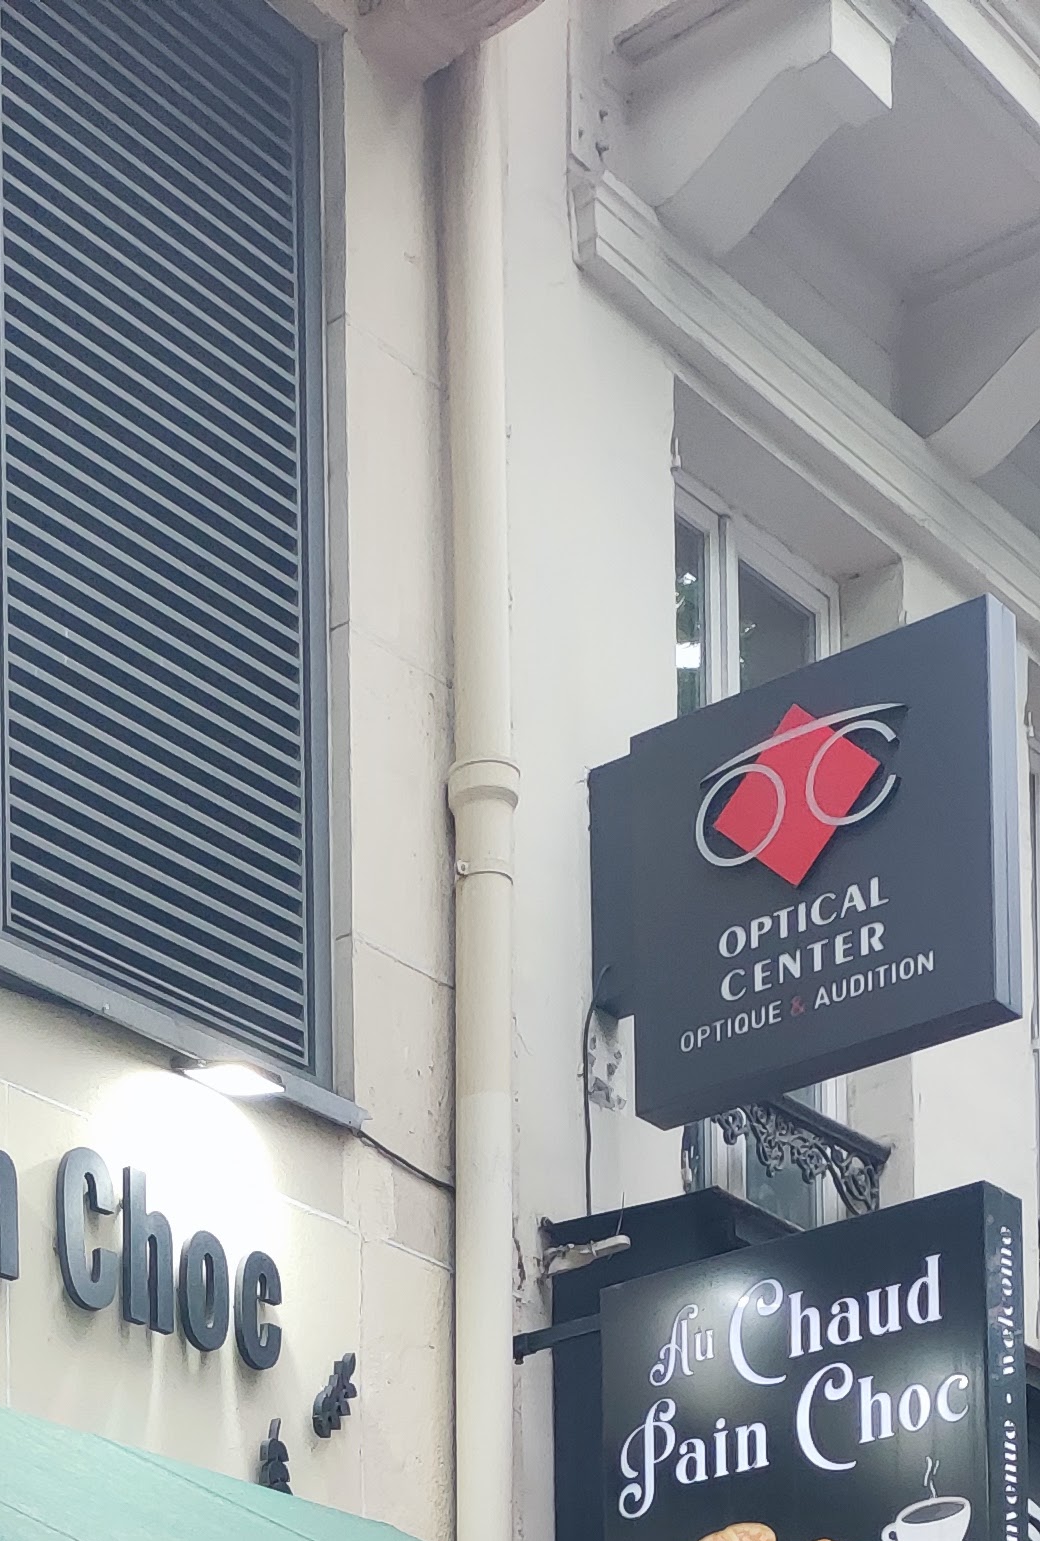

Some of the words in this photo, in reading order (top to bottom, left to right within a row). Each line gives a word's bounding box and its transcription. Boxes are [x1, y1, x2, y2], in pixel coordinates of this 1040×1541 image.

[718, 876, 890, 959] OPTICAL
[720, 921, 886, 1003] CENTER
[679, 998, 782, 1053] OPTIQUE
[790, 995, 805, 1017] &
[814, 949, 936, 1010] AUDITION
[56, 1146, 284, 1371] Choc
[648, 1304, 715, 1386] Au
[728, 1253, 943, 1385] Chaud
[999, 1224, 1017, 1377] welcome
[618, 1398, 769, 1520] Pain
[795, 1362, 969, 1472] Choc
